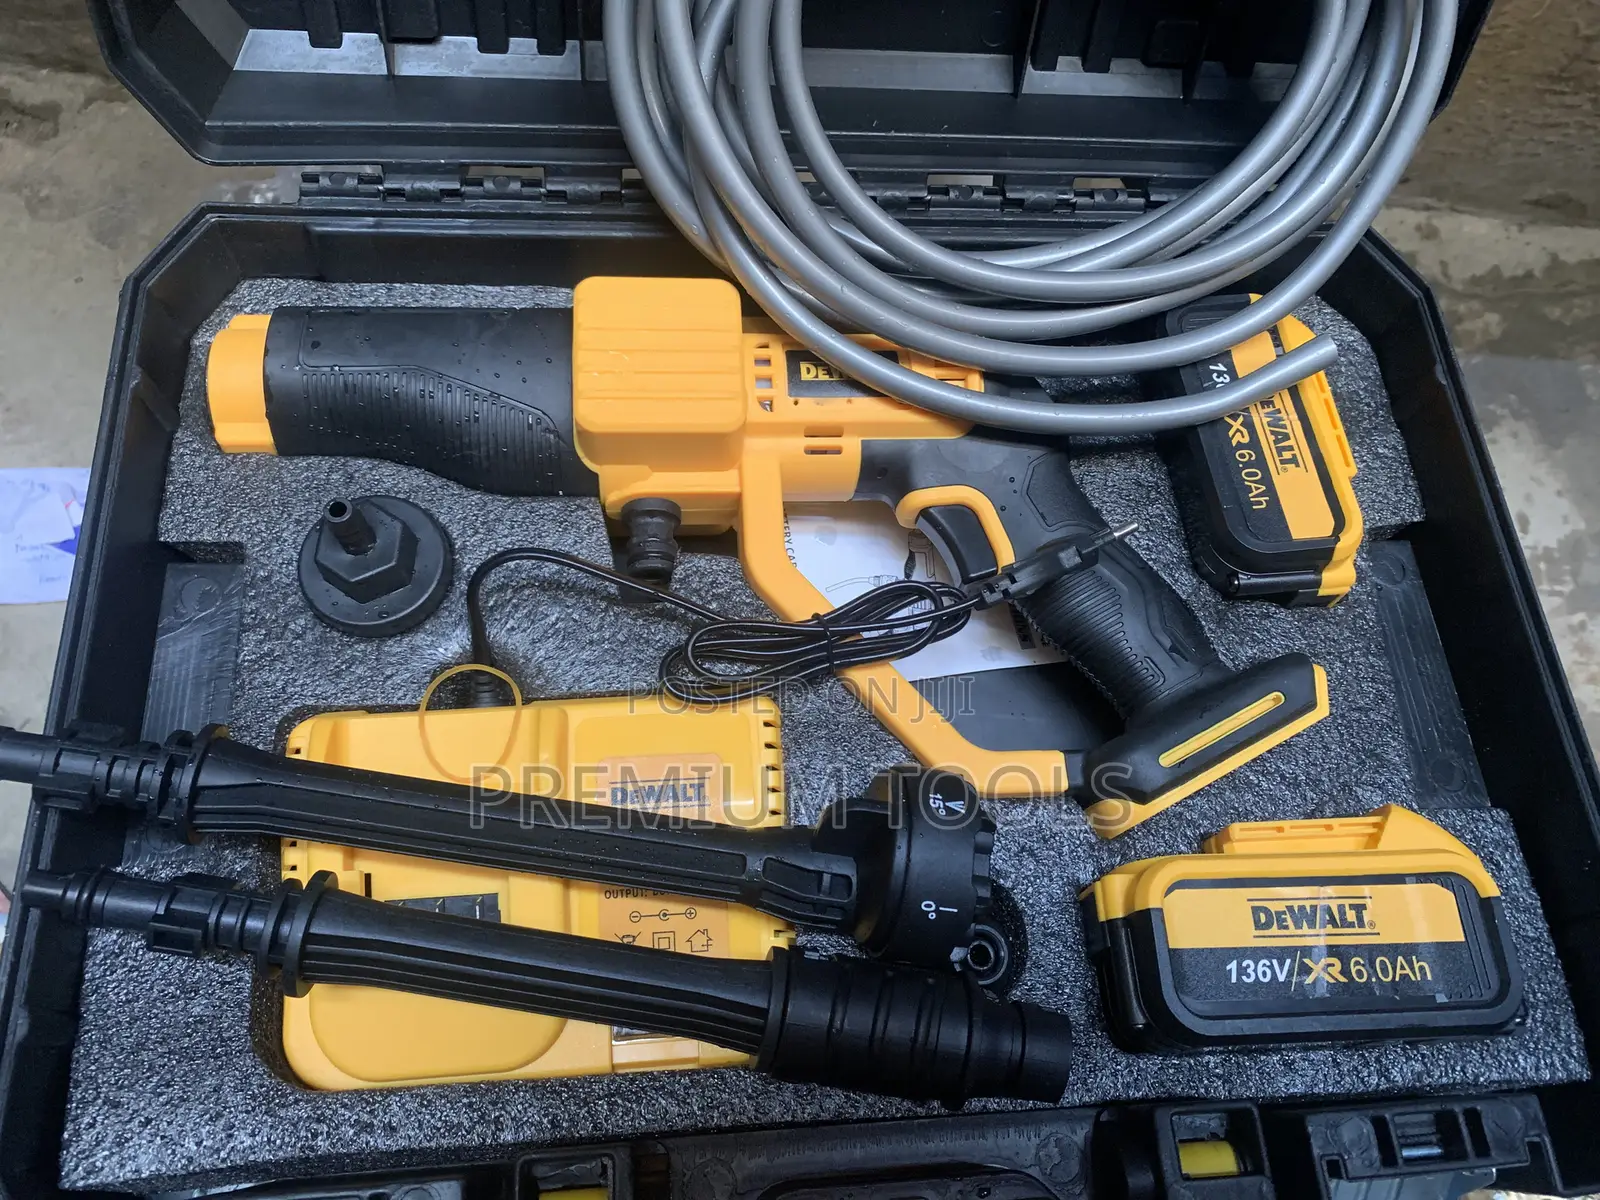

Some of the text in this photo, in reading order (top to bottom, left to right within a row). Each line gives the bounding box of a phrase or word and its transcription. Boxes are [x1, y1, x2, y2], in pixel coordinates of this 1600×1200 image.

[1209, 363, 1230, 387] 13
[1235, 449, 1269, 509] 6.0Ah
[1260, 396, 1301, 469] EWALT
[1350, 955, 1432, 983] 6.0Ah
